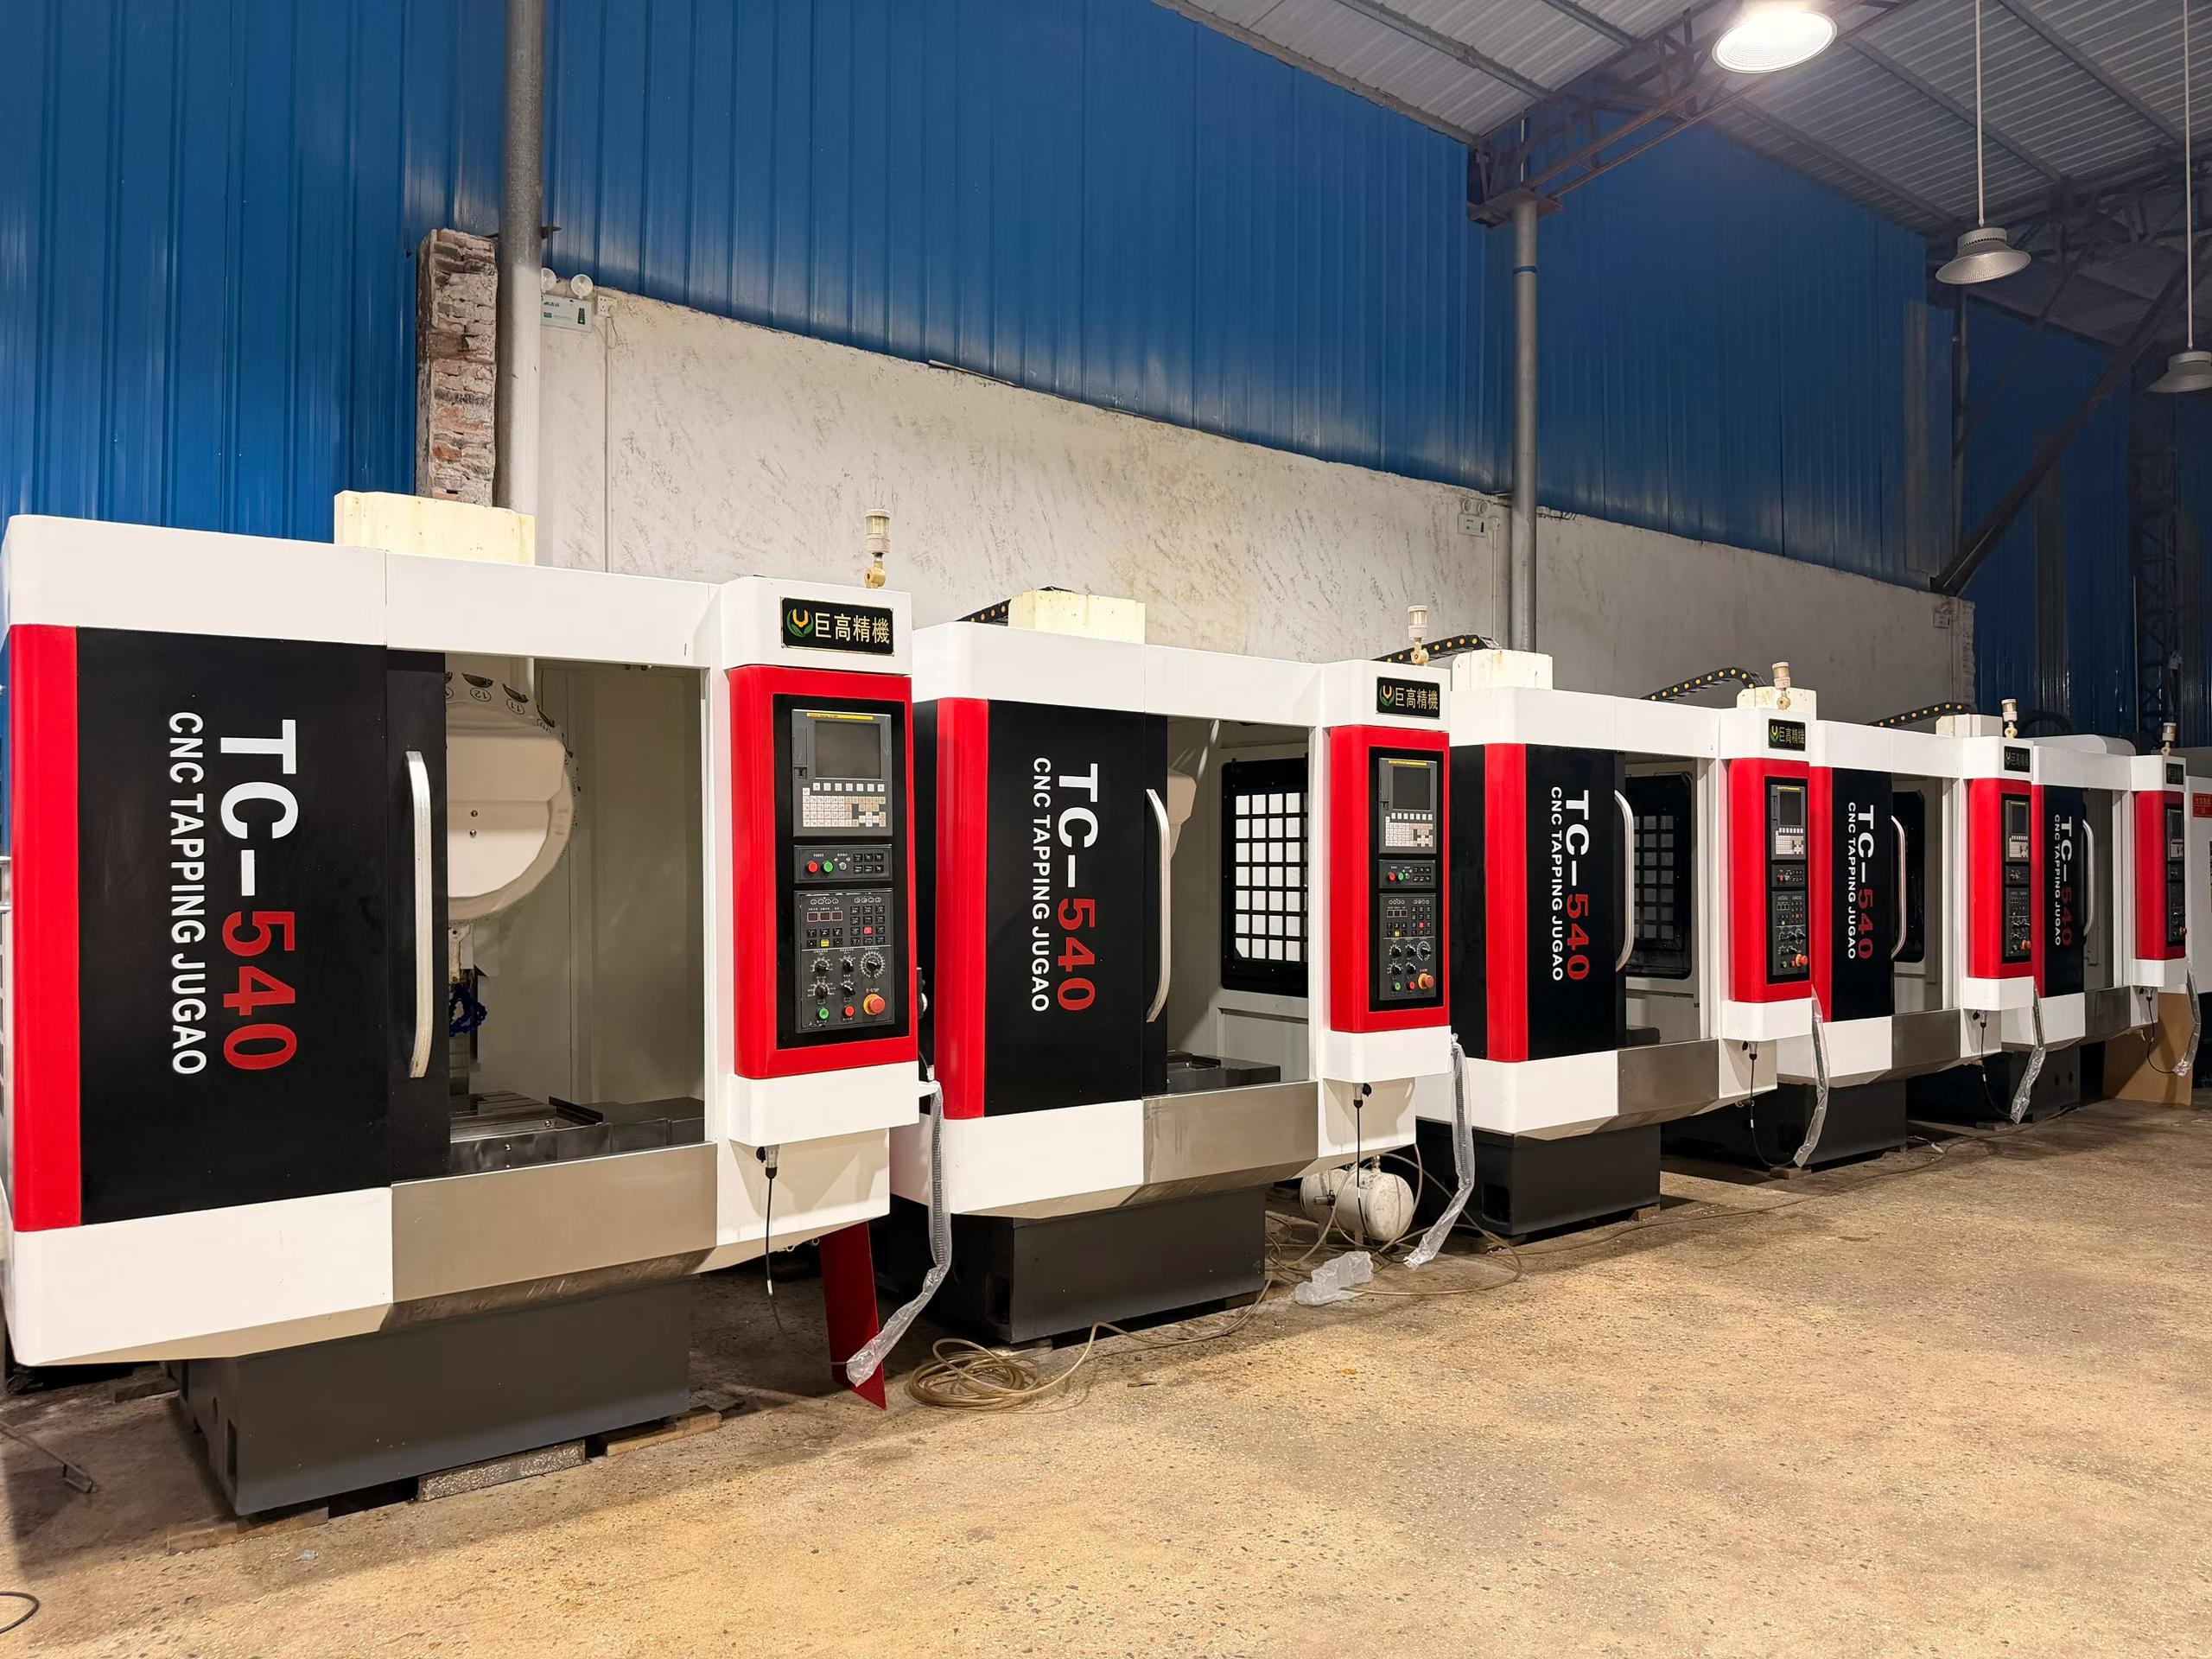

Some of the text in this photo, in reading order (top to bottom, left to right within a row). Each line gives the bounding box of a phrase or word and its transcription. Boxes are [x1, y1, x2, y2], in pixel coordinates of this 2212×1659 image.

[815, 612, 890, 645] 巨高精機
[1395, 687, 1439, 710] 巨高精機
[169, 712, 207, 1075] CNC TAPPING JUGAO
[220, 719, 299, 1071] TC-540
[1031, 757, 1052, 1012] CNC TAPPING JUGAO
[1058, 763, 1098, 1011] TC-540
[1551, 786, 1563, 981] CNC TAPPING JUGAO
[1566, 790, 1590, 981] TC-540
[1847, 802, 1856, 959] CNC TAPPING JUGAO
[1858, 804, 1874, 959] TC-540
